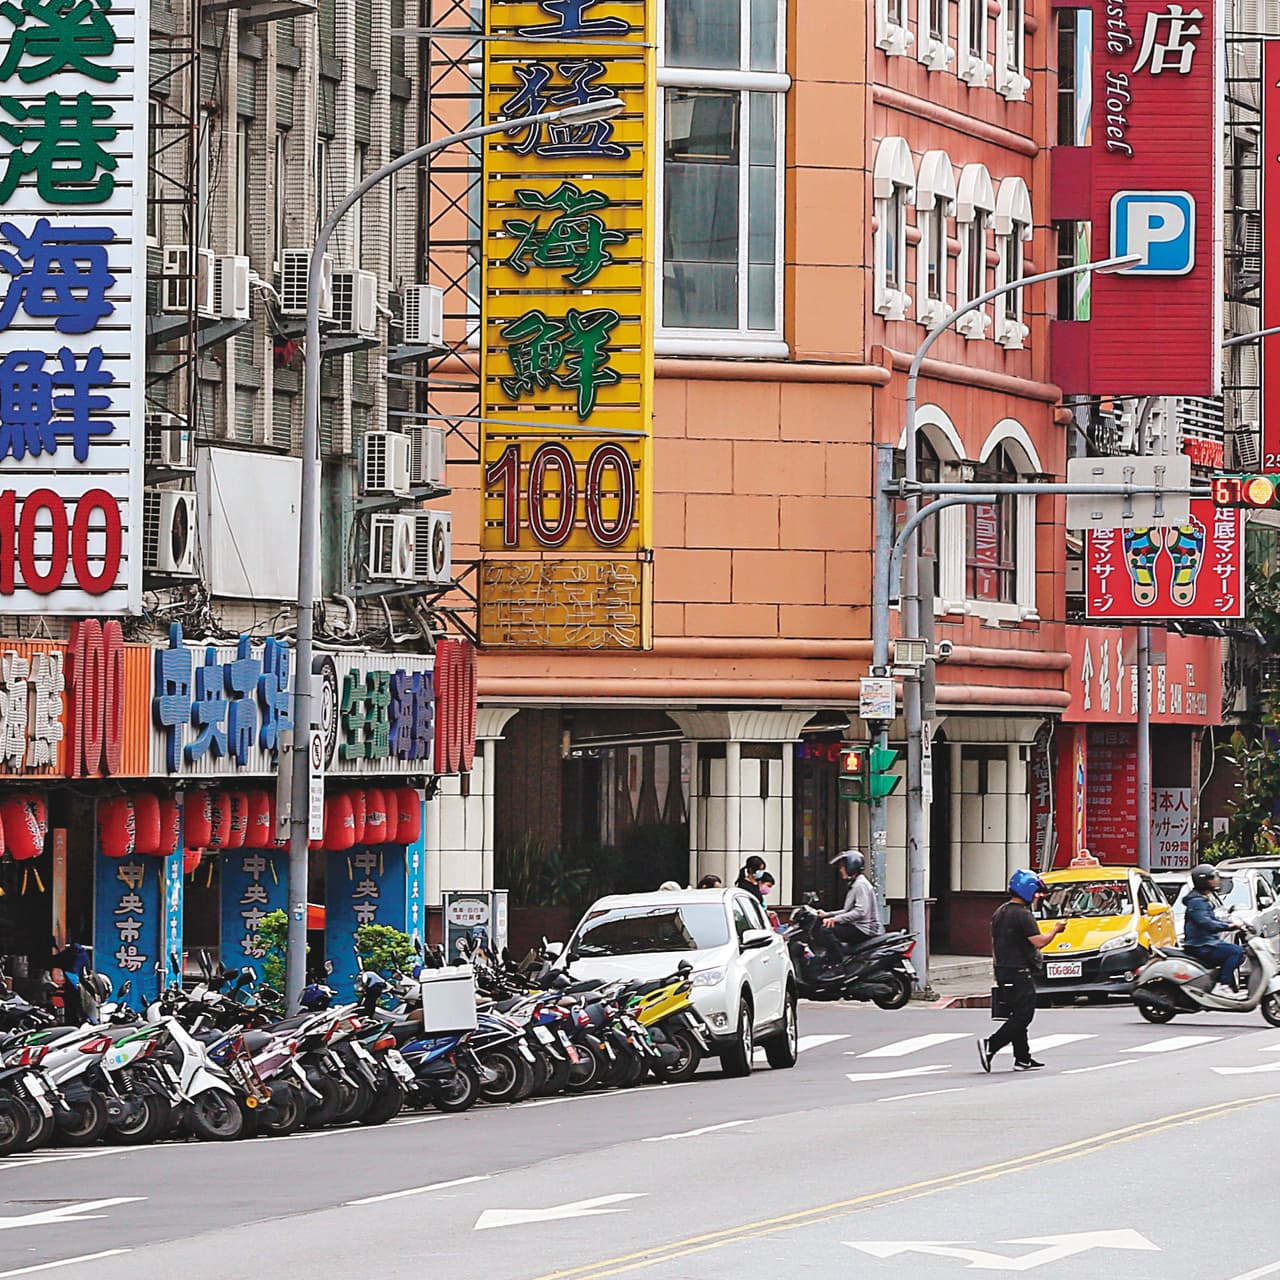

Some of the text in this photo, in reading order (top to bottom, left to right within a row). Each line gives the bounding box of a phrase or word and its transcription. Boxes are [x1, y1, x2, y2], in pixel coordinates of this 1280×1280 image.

[1132, 4, 1204, 75] 店
[1106, 71, 1134, 157] Hotel
[486, 440, 636, 549] 100
[114, 862, 147, 972] 中央市場
[240, 853, 271, 960] 中央市場
